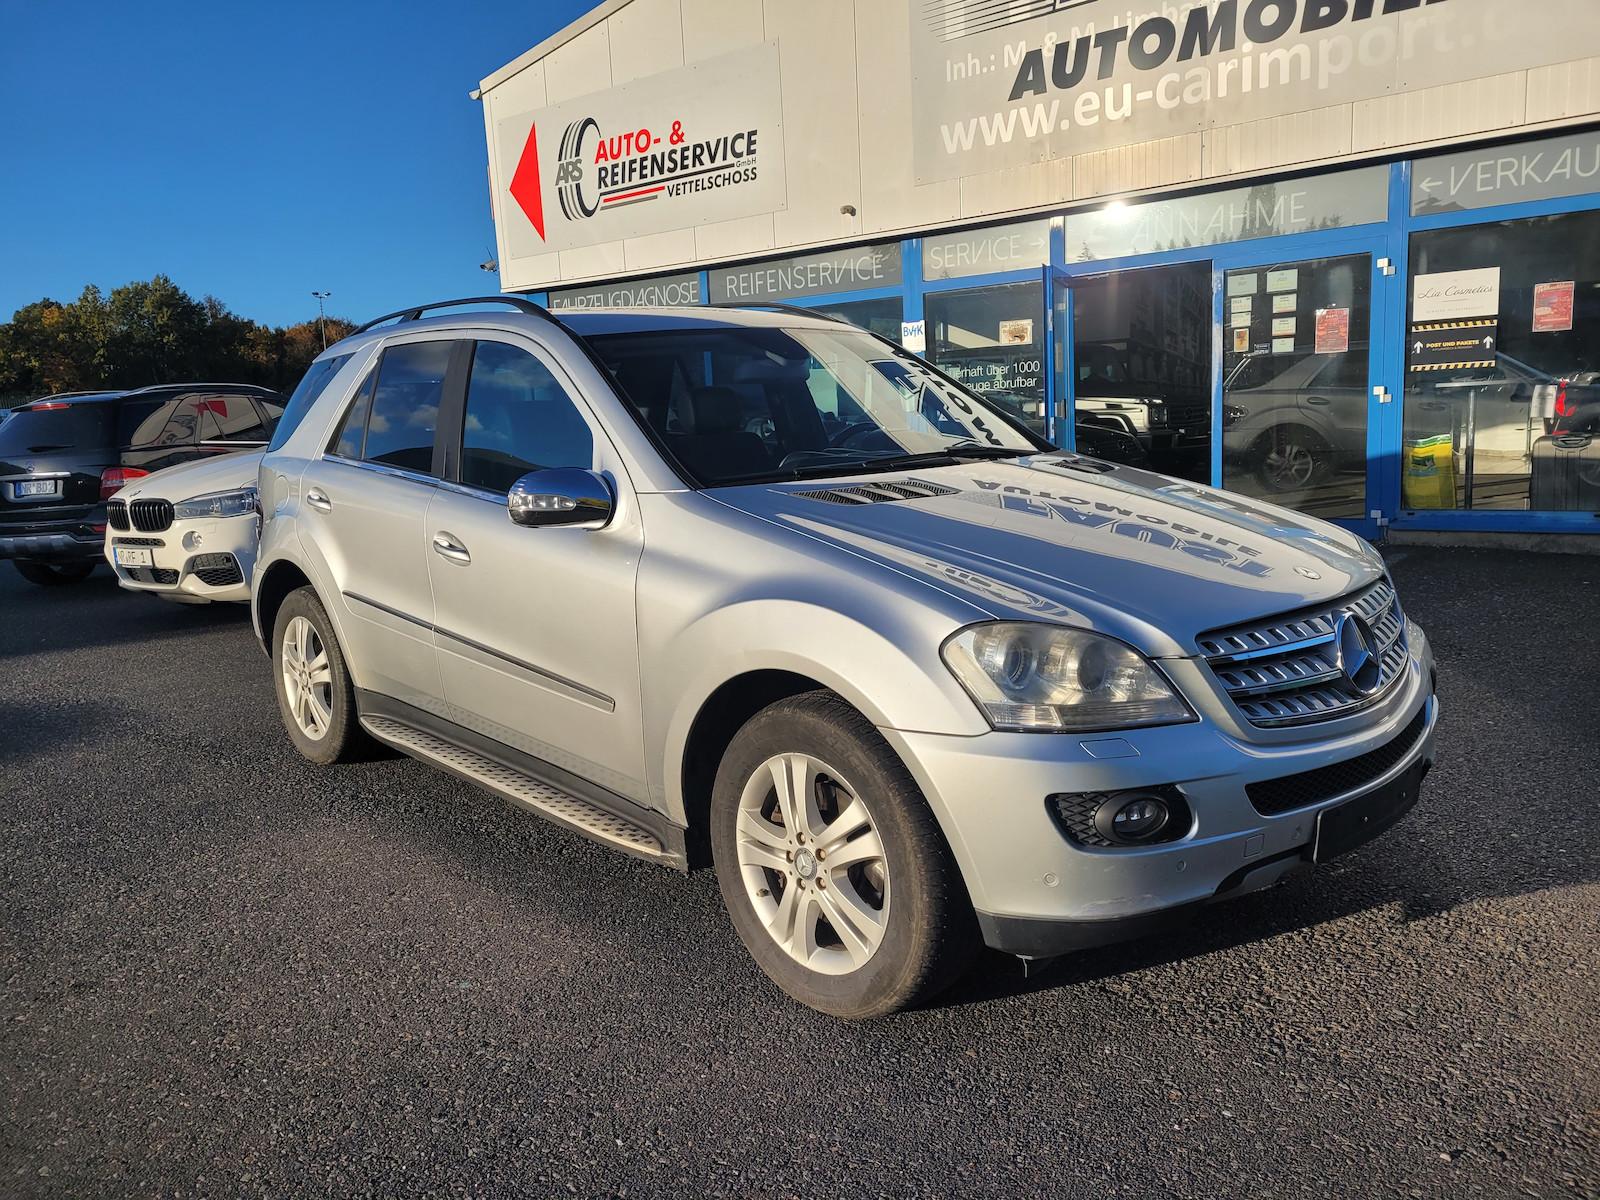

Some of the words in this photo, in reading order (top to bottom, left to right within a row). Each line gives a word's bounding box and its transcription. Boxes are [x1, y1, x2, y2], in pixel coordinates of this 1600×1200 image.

[946, 52, 996, 82] Inh.:
[594, 128, 661, 164] AUTO-
[669, 120, 685, 146] &
[555, 158, 583, 186] ARS
[597, 129, 758, 189] REIFENSERVICE
[735, 157, 757, 168] GmbH
[667, 167, 757, 198] VETTELSCHOSS
[1131, 191, 1307, 245] ANNAHME
[930, 233, 1022, 270] SERVICE
[726, 254, 885, 299] REIFENSERVICE
[1444, 283, 1494, 297] Cosmetics
[1426, 340, 1442, 348] POST
[986, 364, 1009, 376] über
[1013, 360, 1040, 374] 1000
[993, 377, 1038, 389] abrufbar
